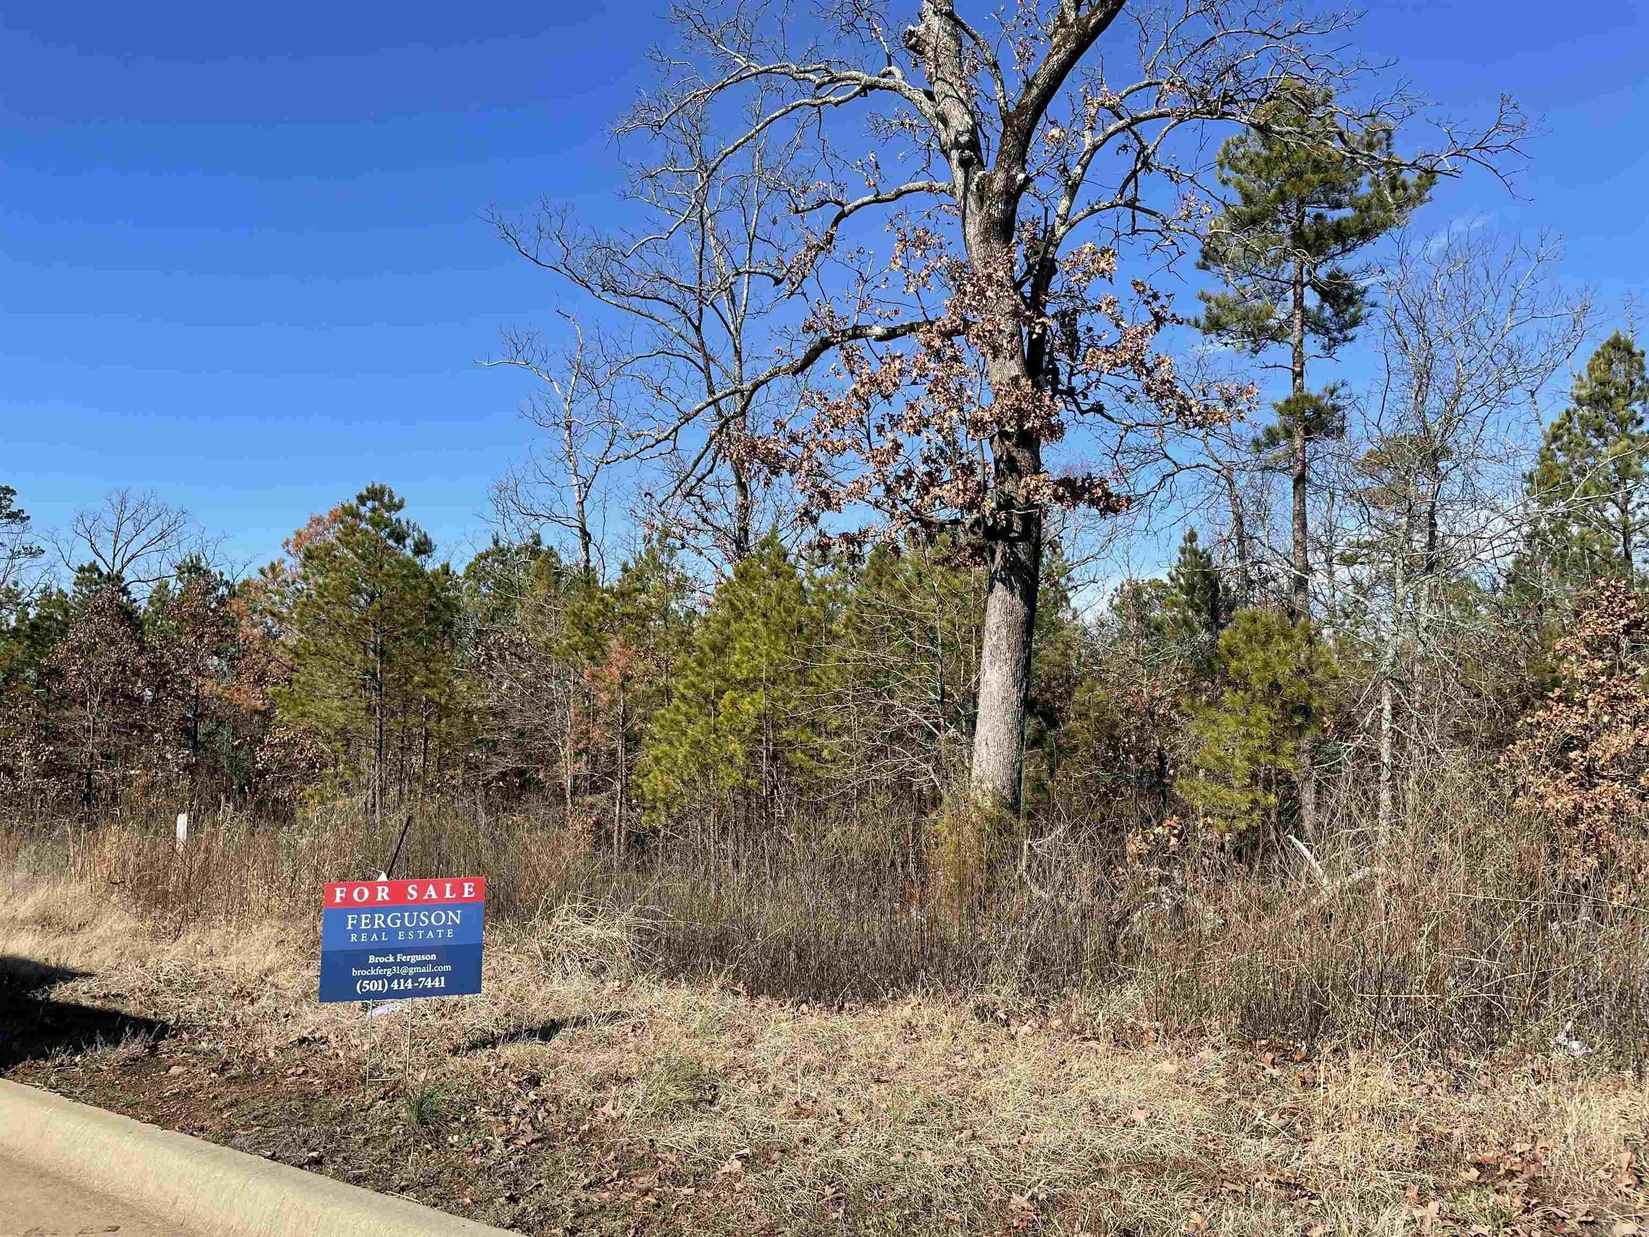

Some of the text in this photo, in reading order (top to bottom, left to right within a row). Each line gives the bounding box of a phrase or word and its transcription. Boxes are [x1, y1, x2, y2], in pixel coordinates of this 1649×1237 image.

[334, 882, 476, 903] FOR SALE
[346, 910, 462, 930] FERGUSON
[351, 929, 455, 942] REAL ESTATE
[368, 953, 437, 964] Brock Ferguson
[352, 964, 452, 978] brockferg31@gmail.com
[356, 976, 446, 994] (501) 414-7441
